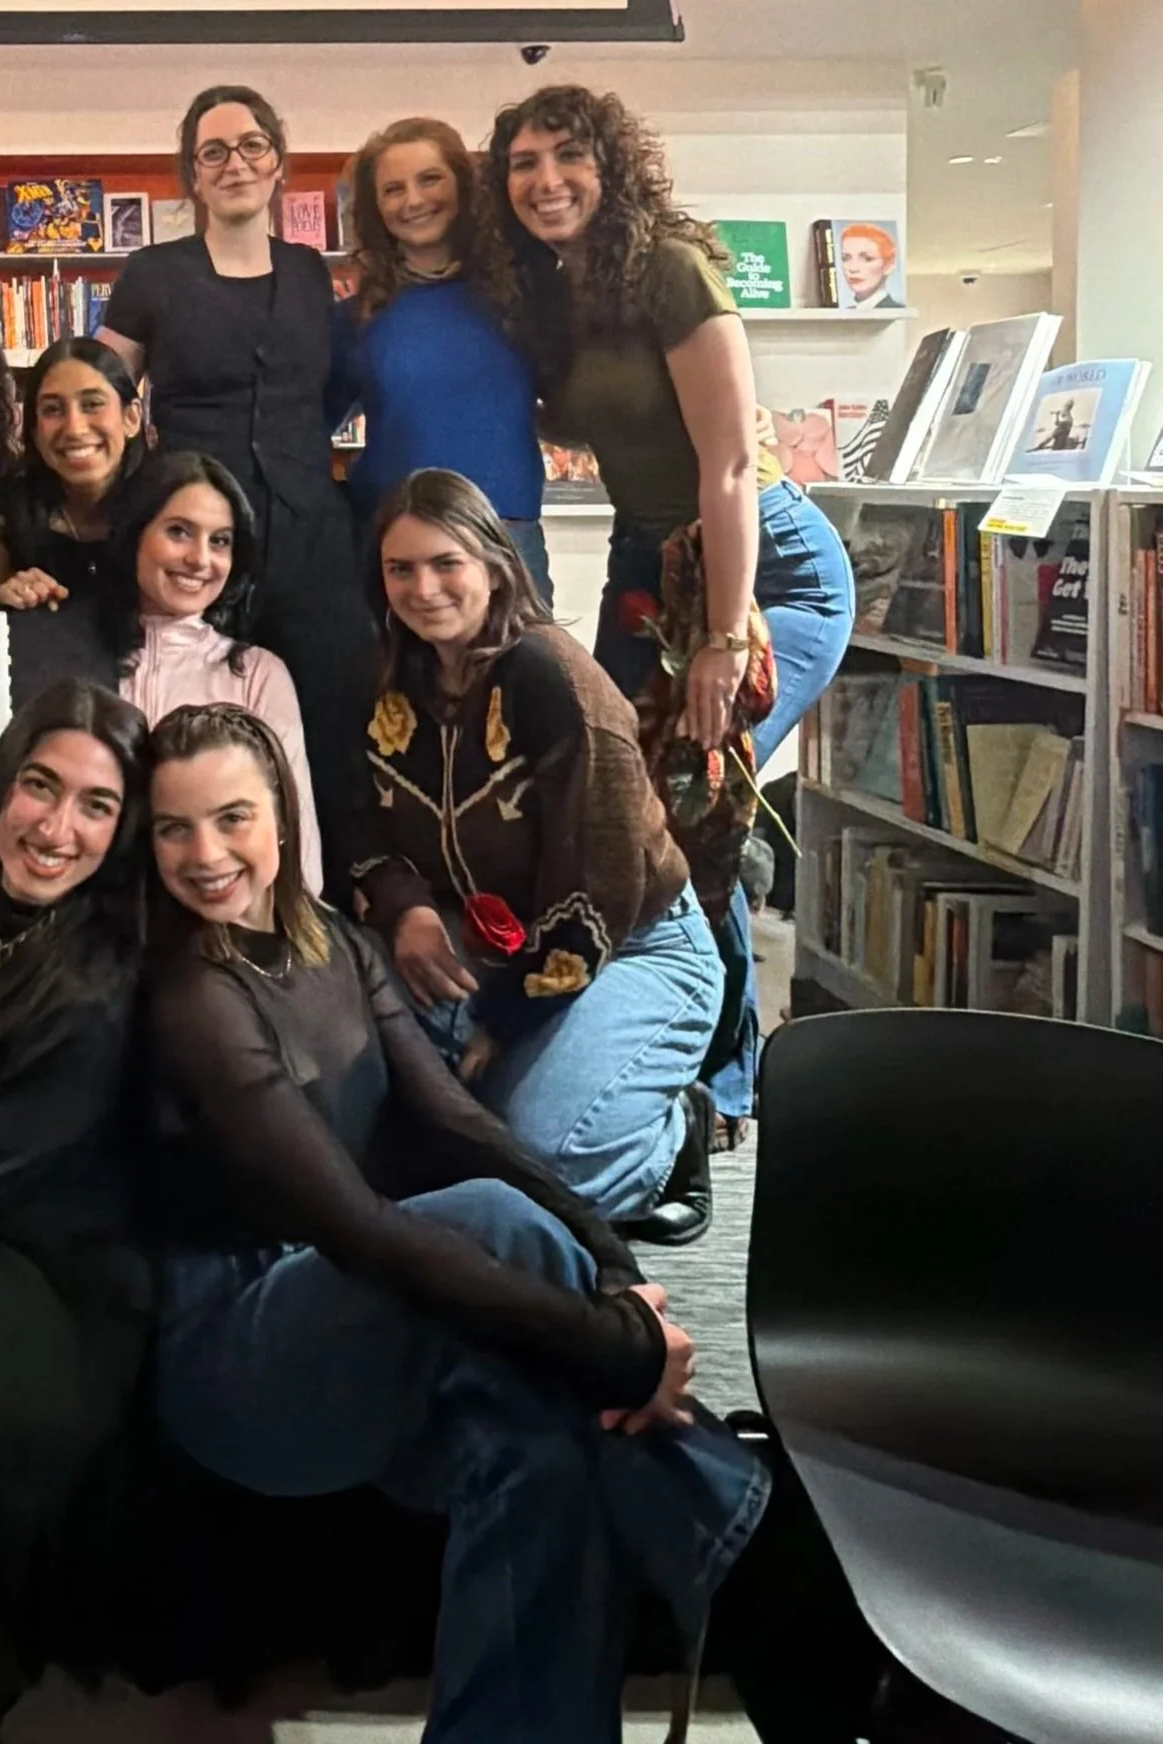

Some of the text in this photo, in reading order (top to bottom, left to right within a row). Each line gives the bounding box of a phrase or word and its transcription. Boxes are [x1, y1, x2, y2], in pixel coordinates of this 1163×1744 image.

[740, 252, 765, 264] The
[736, 262, 771, 273] Guide
[748, 271, 761, 281] to
[726, 276, 783, 292] Becoming
[740, 287, 770, 299] Alive
[1052, 578, 1082, 598] Get
